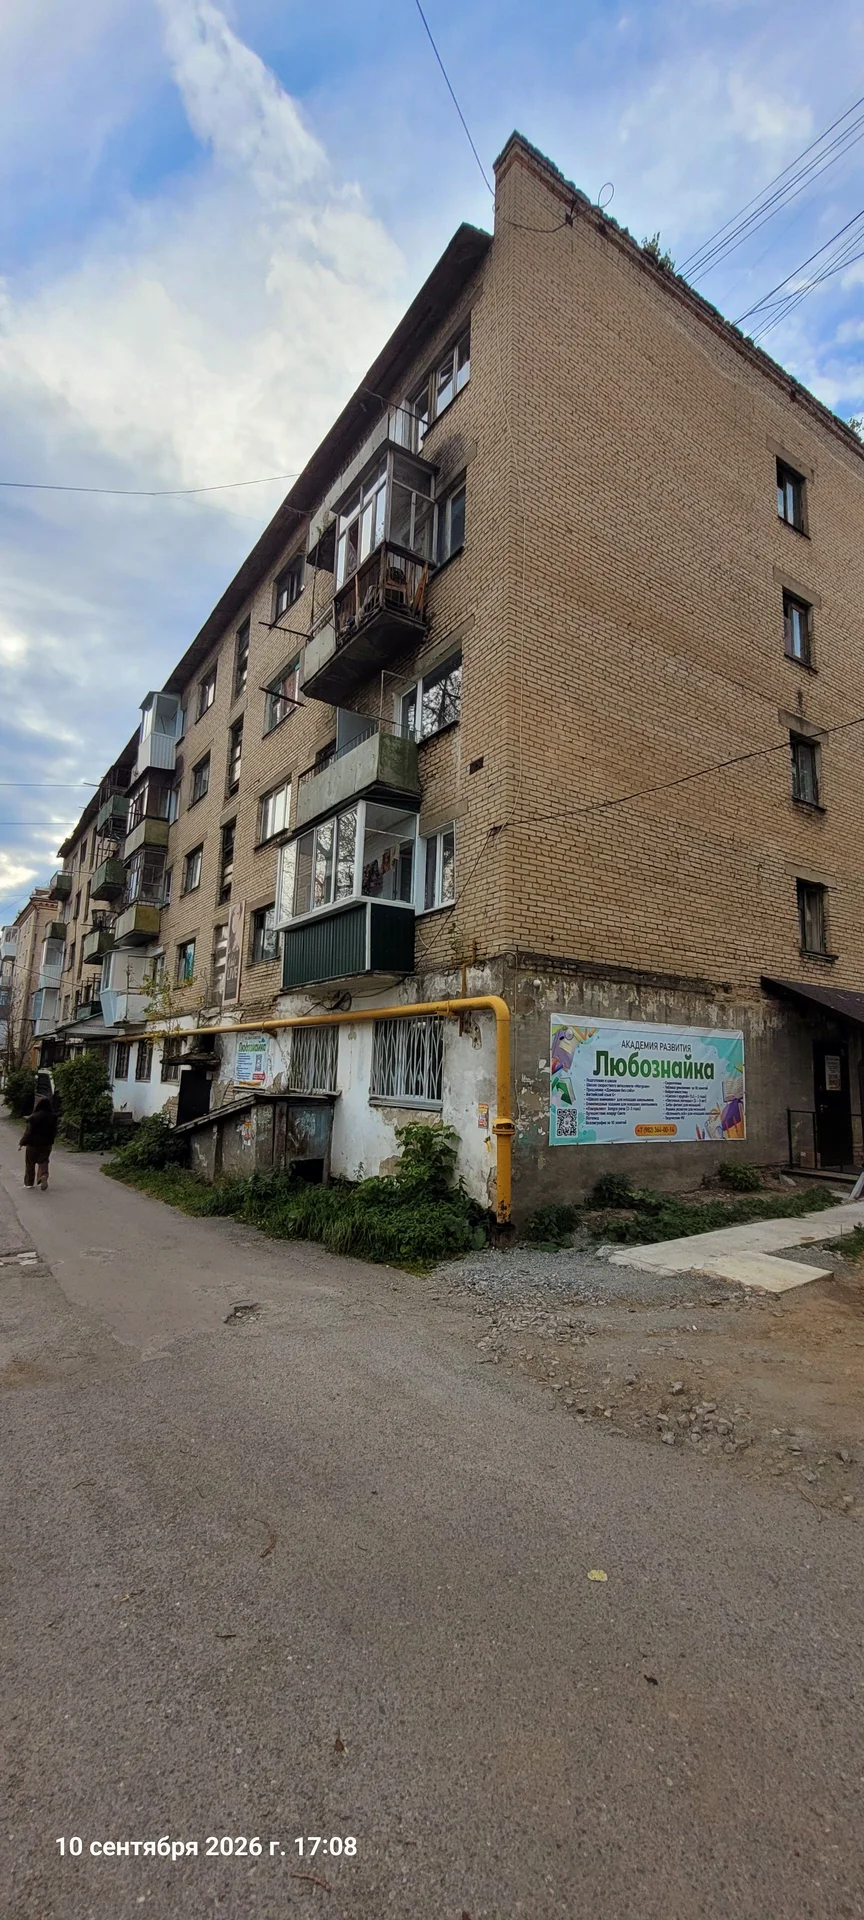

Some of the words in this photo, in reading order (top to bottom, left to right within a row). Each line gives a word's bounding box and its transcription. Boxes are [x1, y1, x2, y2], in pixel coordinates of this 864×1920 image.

[621, 1040, 658, 1051] АКАДЕМИЯ
[660, 1043, 691, 1052] РАЗВИТИЯ
[593, 1050, 714, 1080] Любознайка
